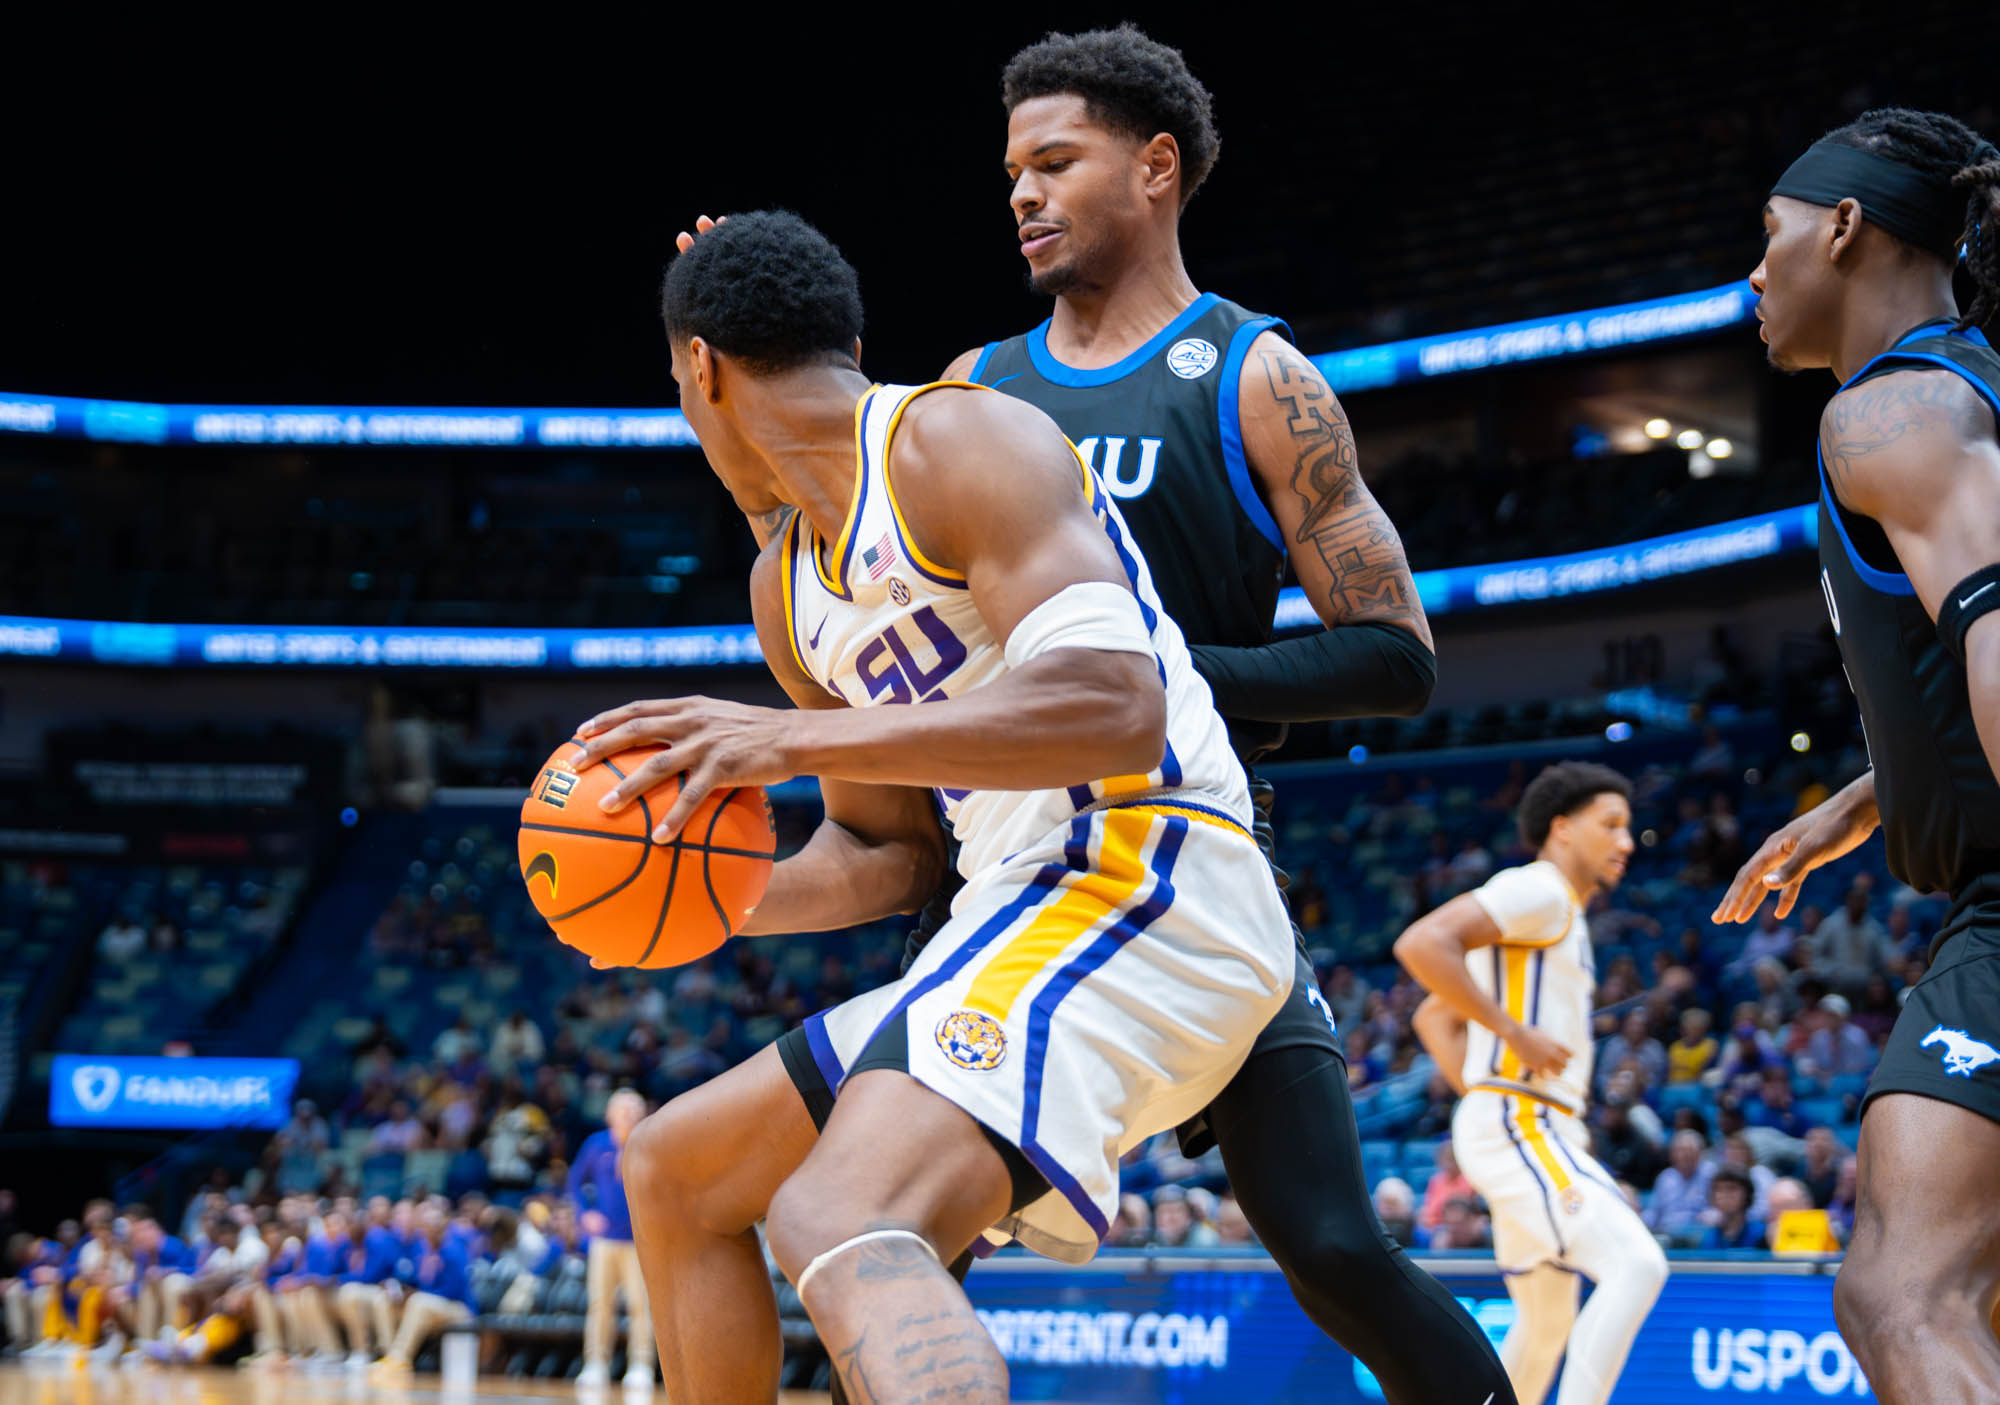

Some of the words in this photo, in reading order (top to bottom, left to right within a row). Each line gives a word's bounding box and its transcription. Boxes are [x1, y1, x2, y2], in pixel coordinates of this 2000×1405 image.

[1075, 436, 1164, 500] U
[828, 604, 968, 705] SU
[974, 1309, 1229, 1367] RTSENT.COM
